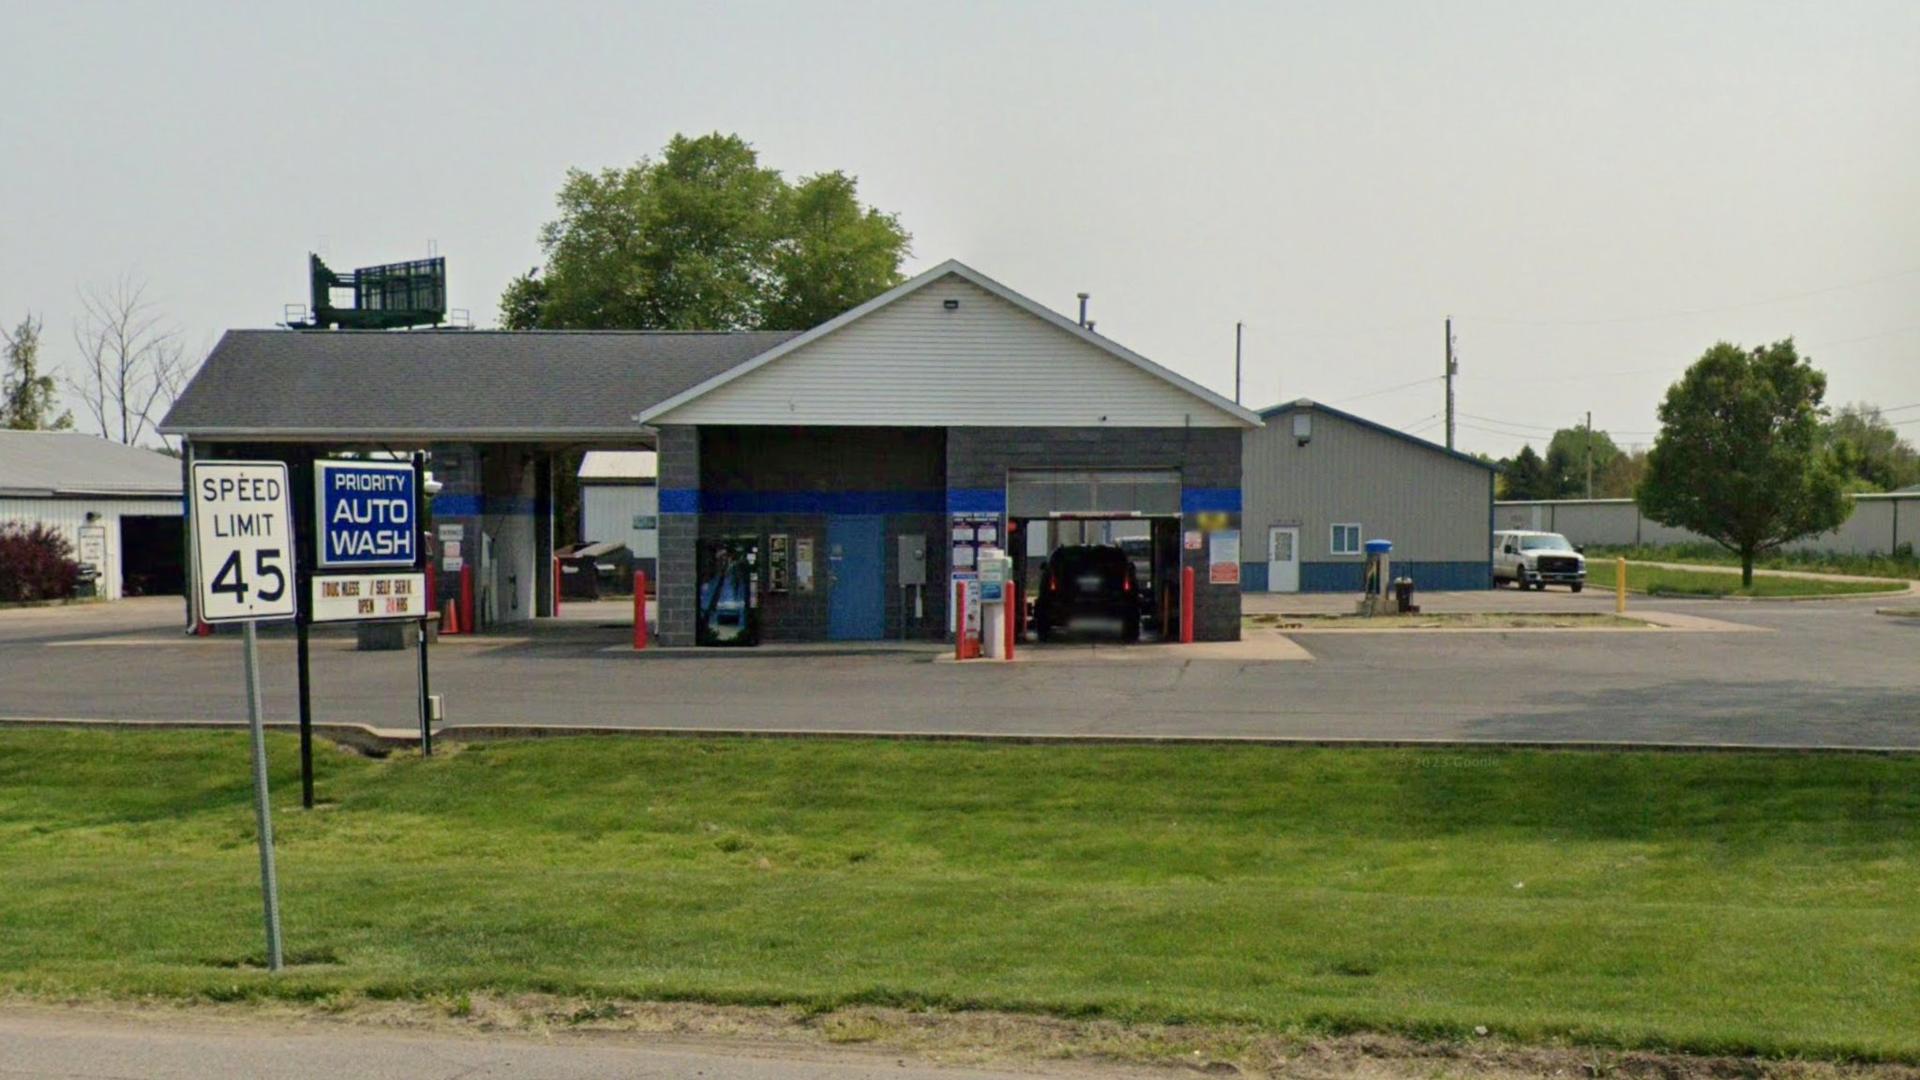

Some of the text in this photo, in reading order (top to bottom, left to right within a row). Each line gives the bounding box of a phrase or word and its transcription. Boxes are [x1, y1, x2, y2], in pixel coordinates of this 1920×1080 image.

[203, 478, 280, 502] SPEED
[335, 474, 405, 491] PRIORITY
[333, 499, 408, 523] AUTO
[214, 514, 273, 537] LIMIT
[331, 530, 411, 555] WASH
[211, 548, 285, 604] 45
[358, 599, 374, 614] OPEN
